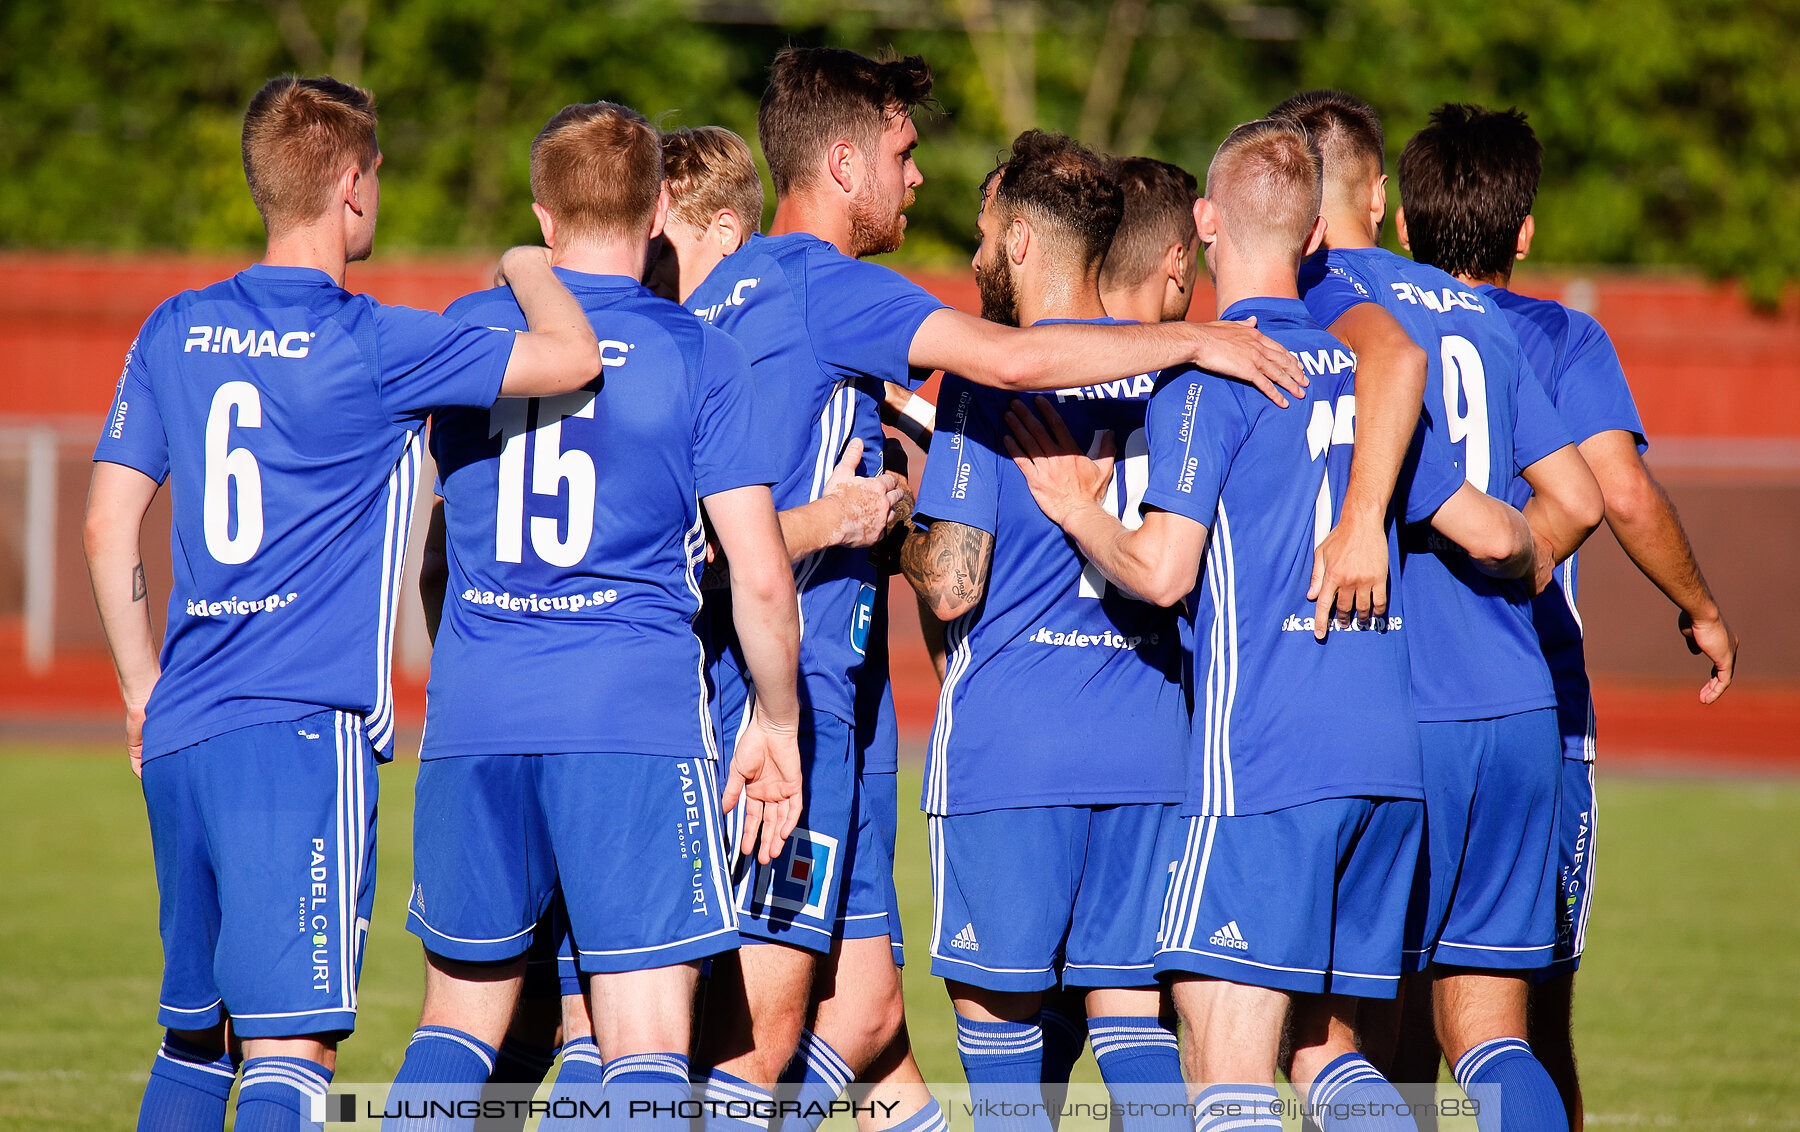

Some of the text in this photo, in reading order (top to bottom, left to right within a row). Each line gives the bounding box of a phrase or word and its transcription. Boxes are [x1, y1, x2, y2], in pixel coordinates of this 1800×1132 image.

[111, 401, 129, 439] DAVID
[1441, 335, 1490, 494] 9
[203, 381, 264, 565] 6
[488, 390, 597, 568] 15
[955, 463, 971, 500] DAVID
[1181, 457, 1199, 494] DAVID
[676, 762, 700, 834] PADEL
[310, 838, 326, 910] PADEL
[950, 939, 979, 951] adidas
[1209, 936, 1249, 950] adidas
